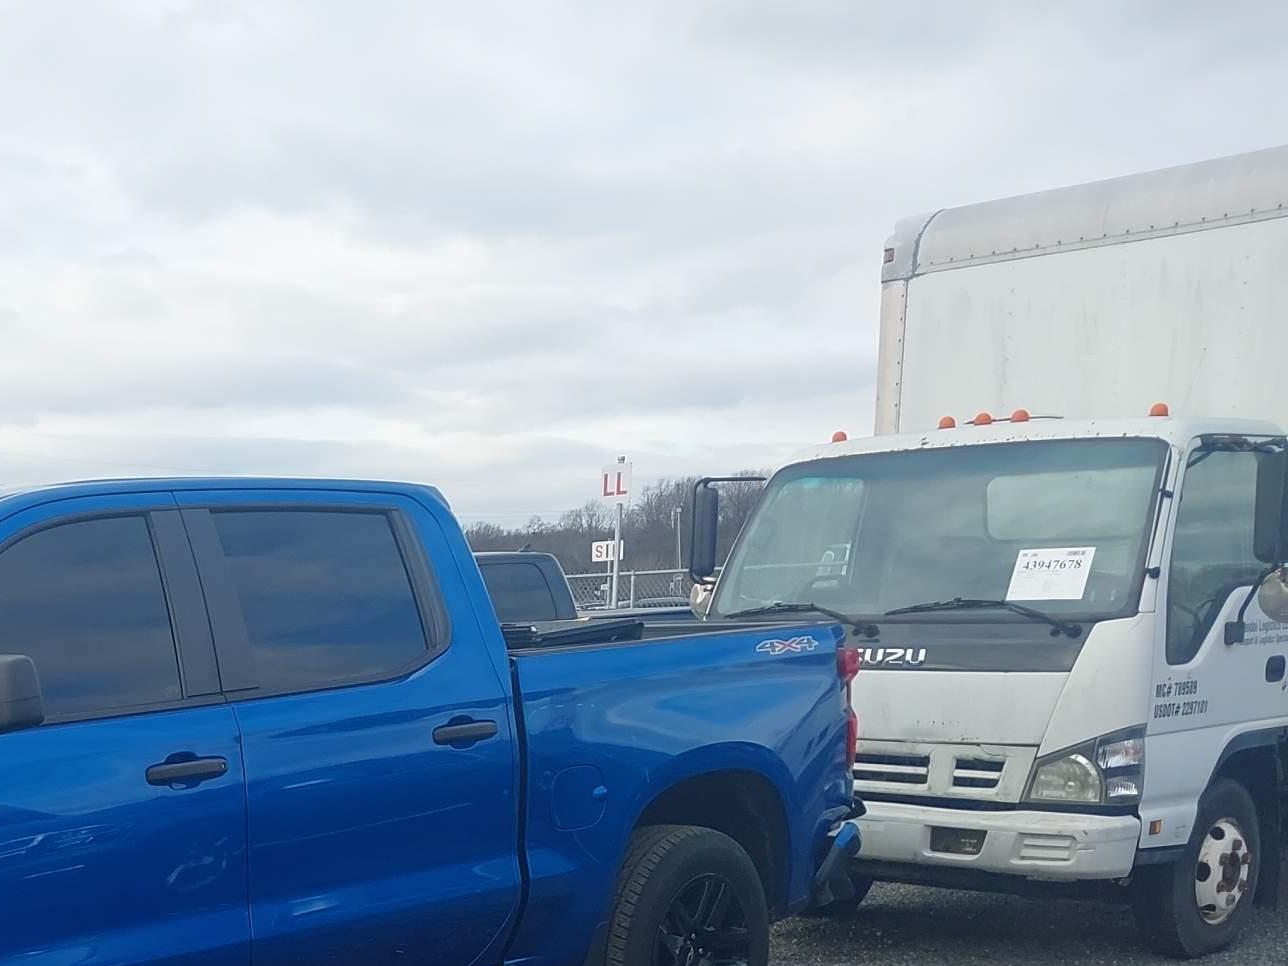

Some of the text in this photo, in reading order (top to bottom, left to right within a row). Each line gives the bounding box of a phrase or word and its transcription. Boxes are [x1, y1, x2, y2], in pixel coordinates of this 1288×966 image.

[603, 471, 628, 497] LL
[1022, 559, 1083, 570] 43947678
[1155, 683, 1173, 698] MC#
[1154, 703, 1181, 718] USDOT#
